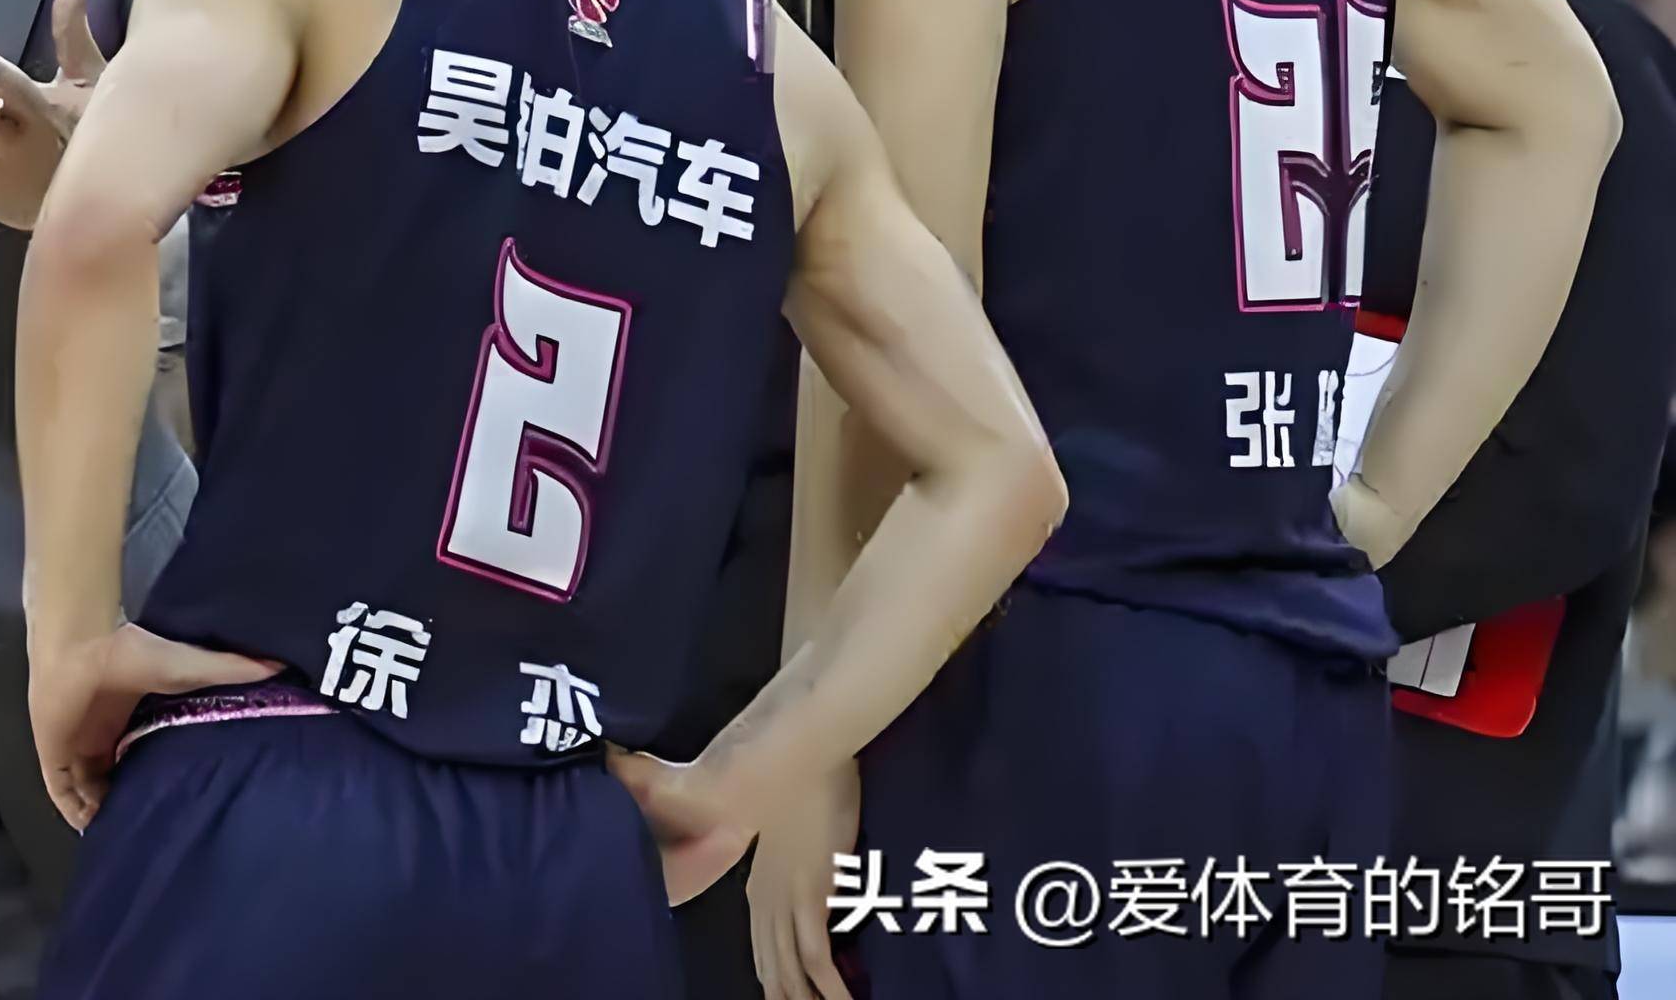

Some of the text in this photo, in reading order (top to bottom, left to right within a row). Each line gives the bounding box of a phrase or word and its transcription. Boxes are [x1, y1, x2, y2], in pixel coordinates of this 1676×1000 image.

[417, 48, 760, 248] 昊铂汽车
[436, 236, 632, 602] 2
